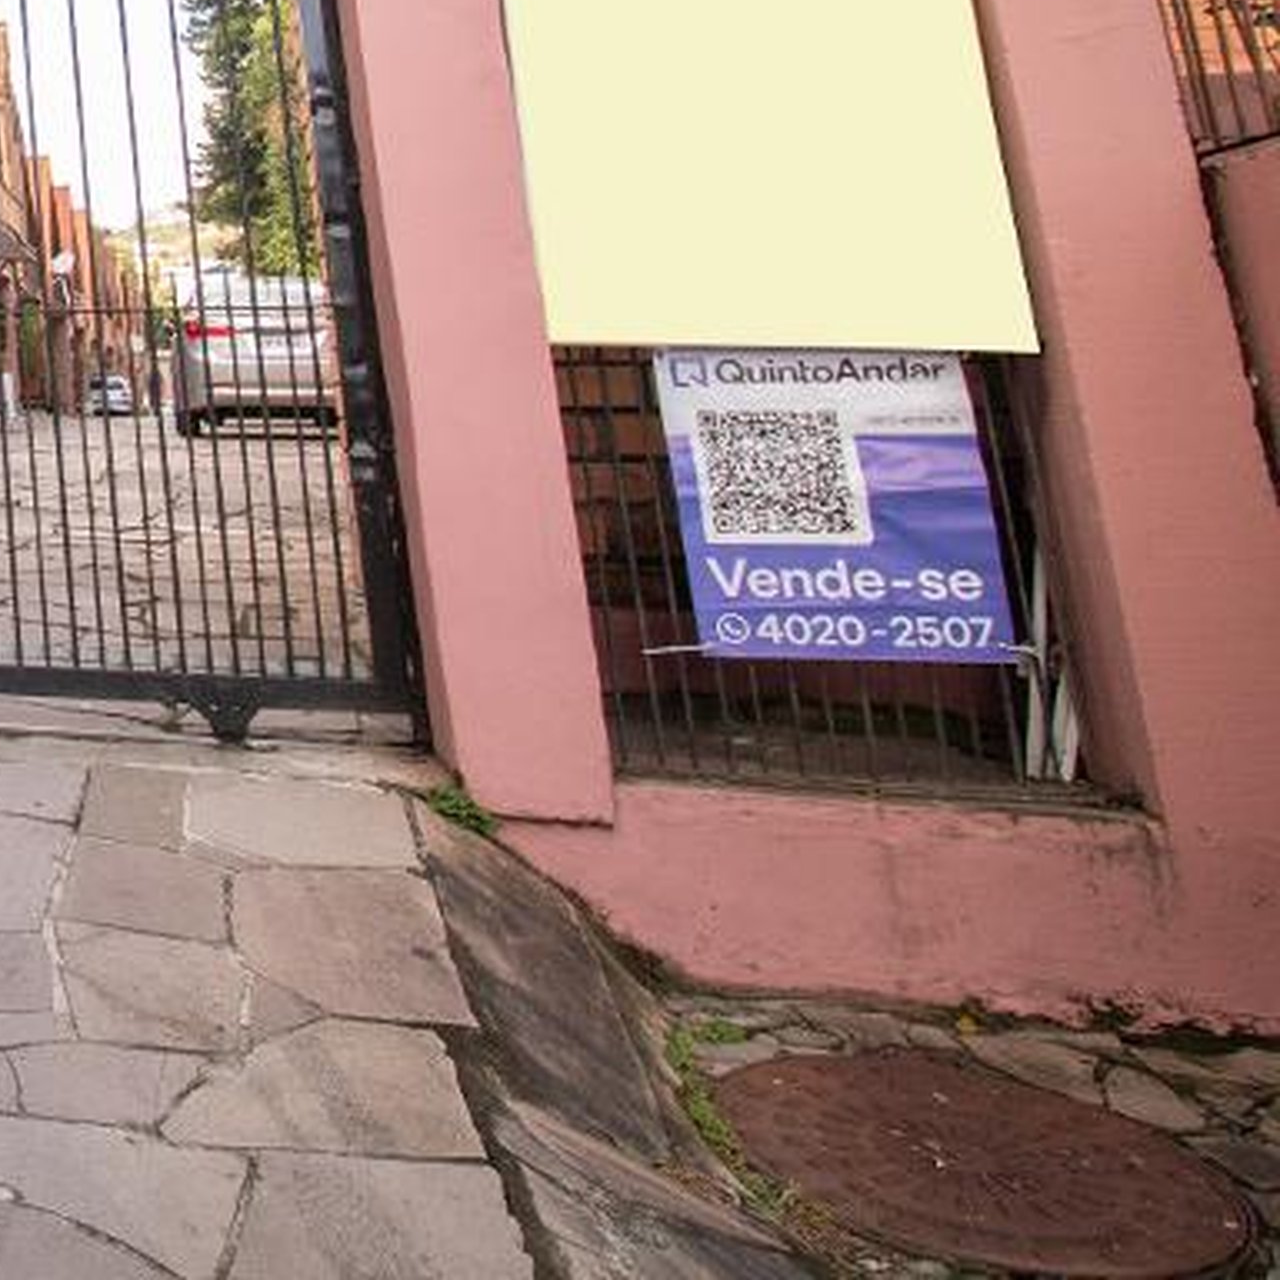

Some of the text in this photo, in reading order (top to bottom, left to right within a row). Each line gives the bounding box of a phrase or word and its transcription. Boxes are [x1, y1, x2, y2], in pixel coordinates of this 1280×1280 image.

[715, 357, 946, 385] QuintoAndar
[705, 558, 984, 601] Vende-se
[755, 612, 993, 649] 4020-2507
